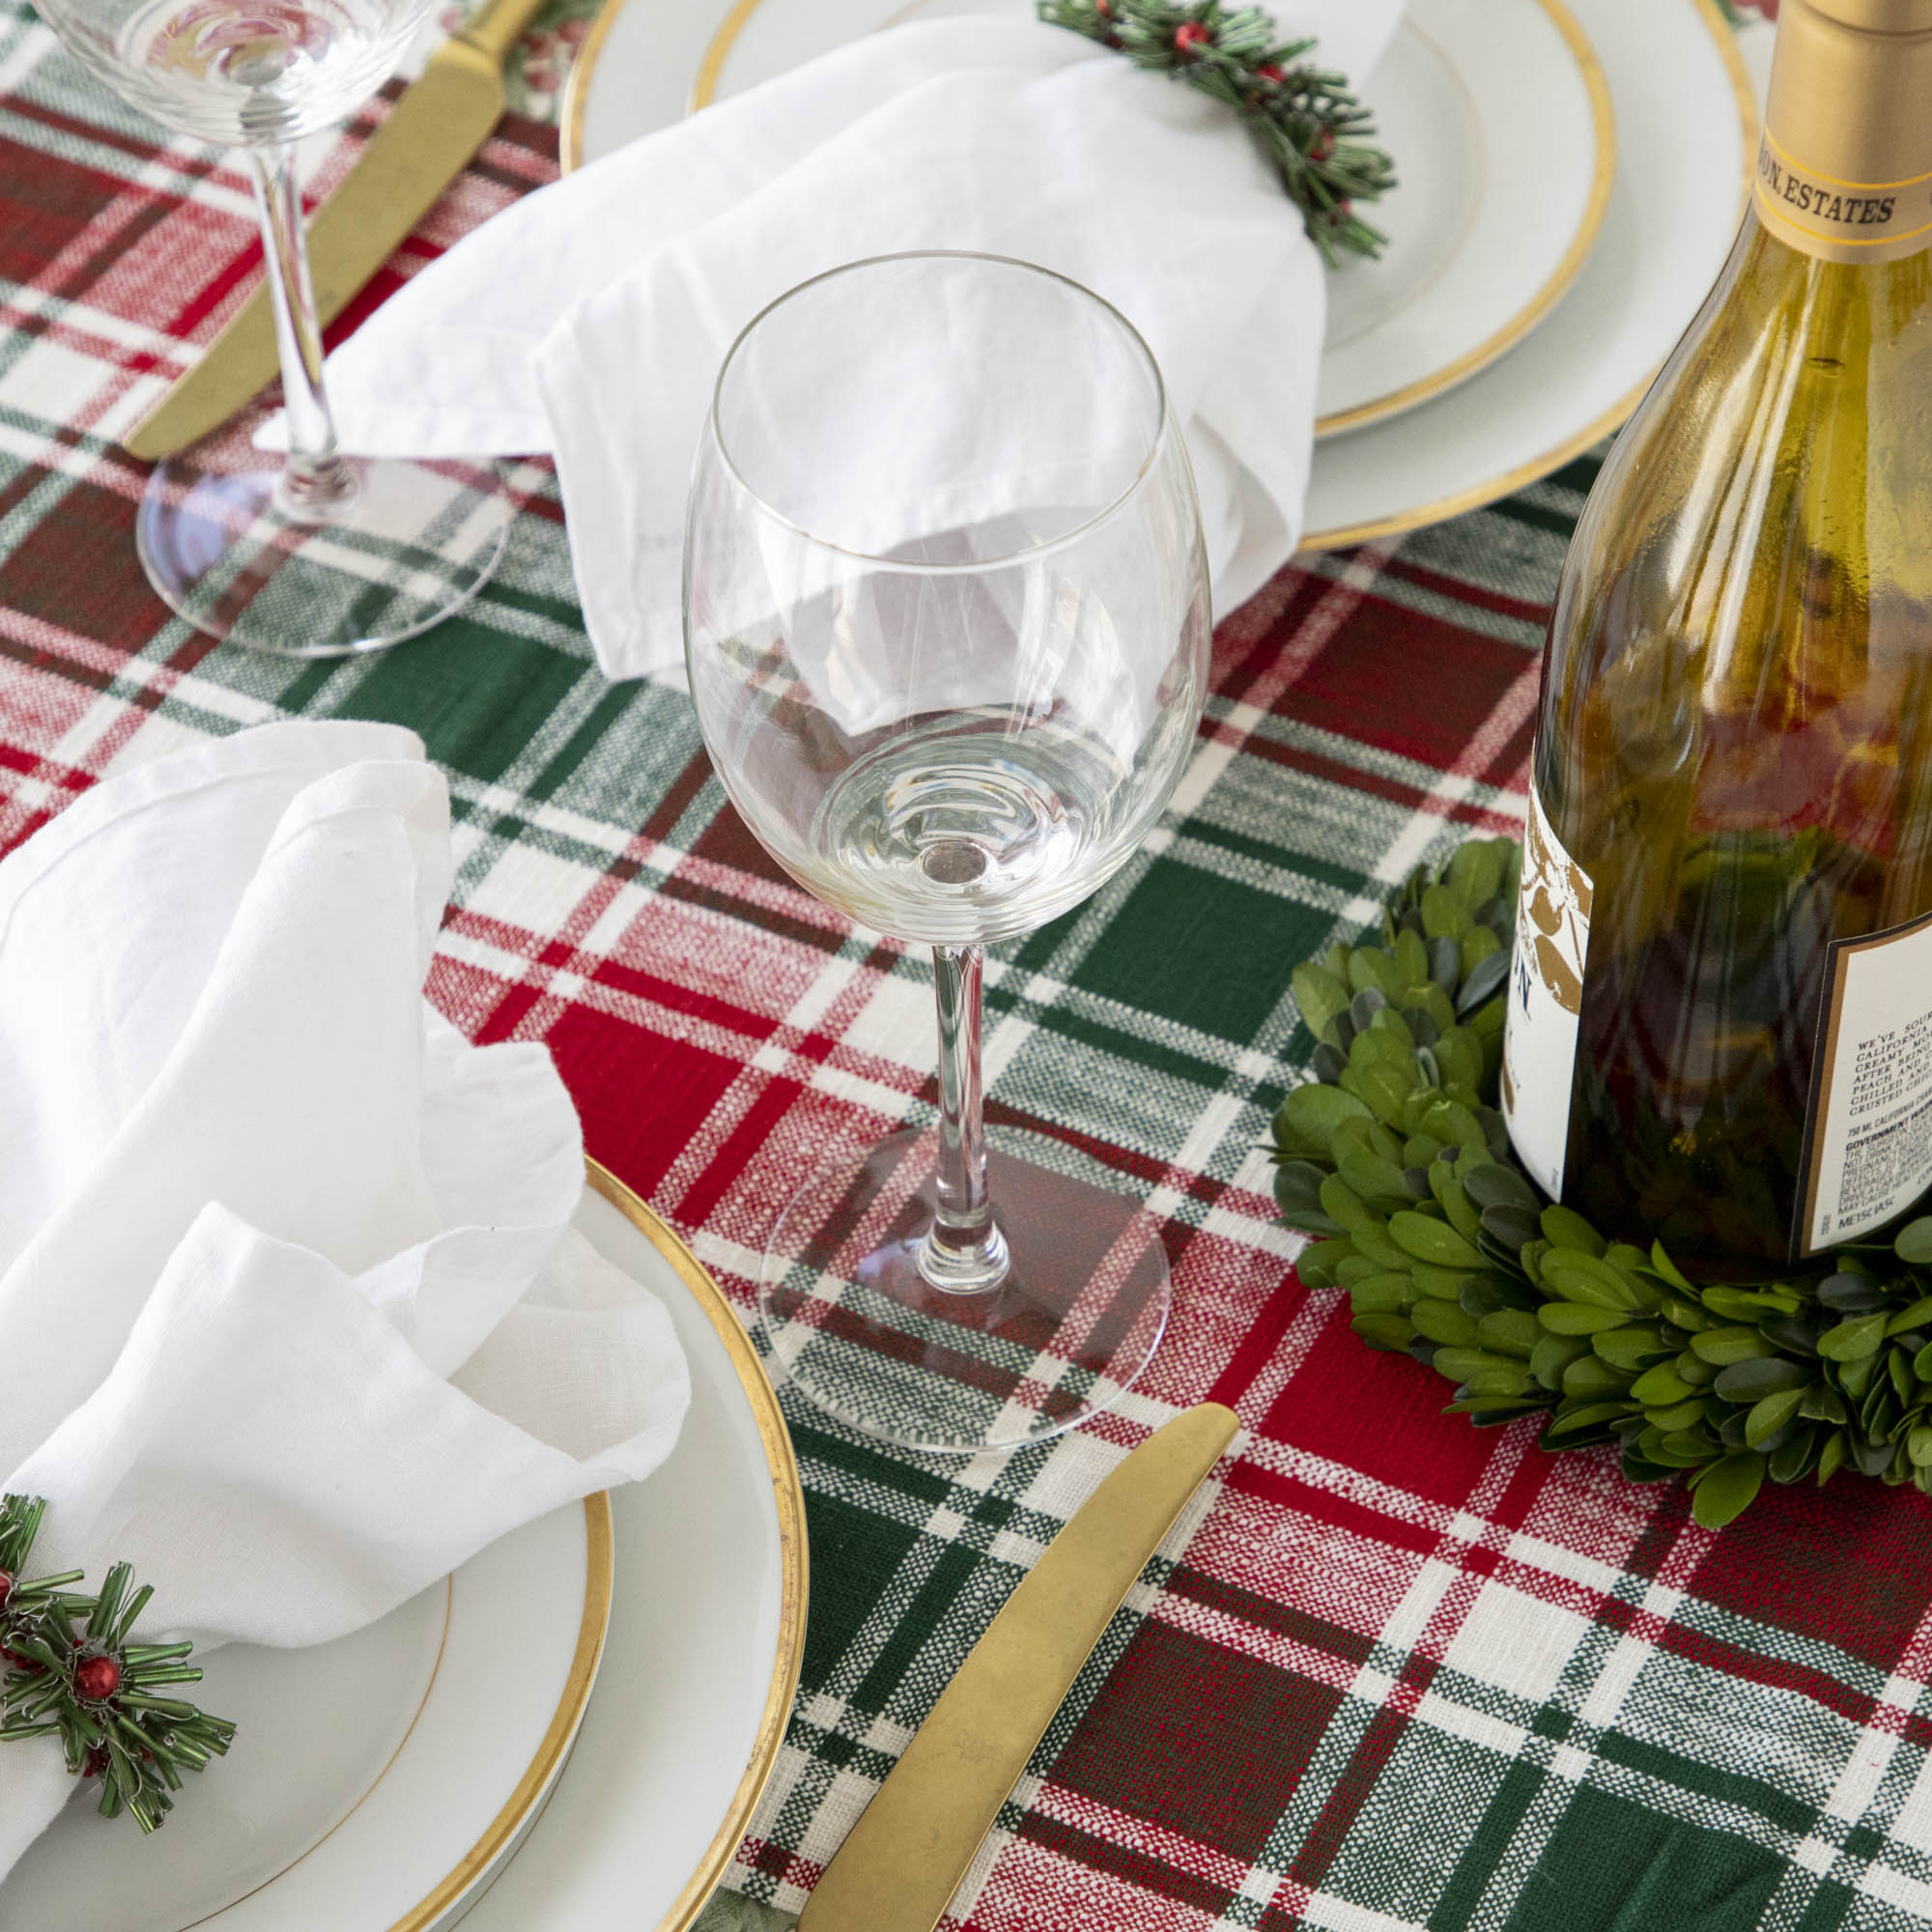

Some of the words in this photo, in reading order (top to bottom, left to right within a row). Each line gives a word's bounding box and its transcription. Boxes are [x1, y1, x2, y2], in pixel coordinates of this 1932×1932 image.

[1784, 174, 1895, 225] ESTATES
[1855, 1047, 1905, 1073] CREAMY
[1913, 1030, 1932, 1049] MO
[1856, 1025, 1927, 1062] CALIFORNIA
[1858, 1031, 1895, 1051] WE'VE
[1852, 1073, 1892, 1094] PEACH
[1898, 1059, 1920, 1077] AND
[1854, 1064, 1891, 1085] AFTER
[1898, 1041, 1930, 1067] BEING
[1851, 1079, 1902, 1105] CHILLED
[1909, 1062, 1929, 1081] AND
[1849, 1089, 1902, 1116] CRUSTED
[1846, 1116, 1909, 1151] GOVERNMENT
